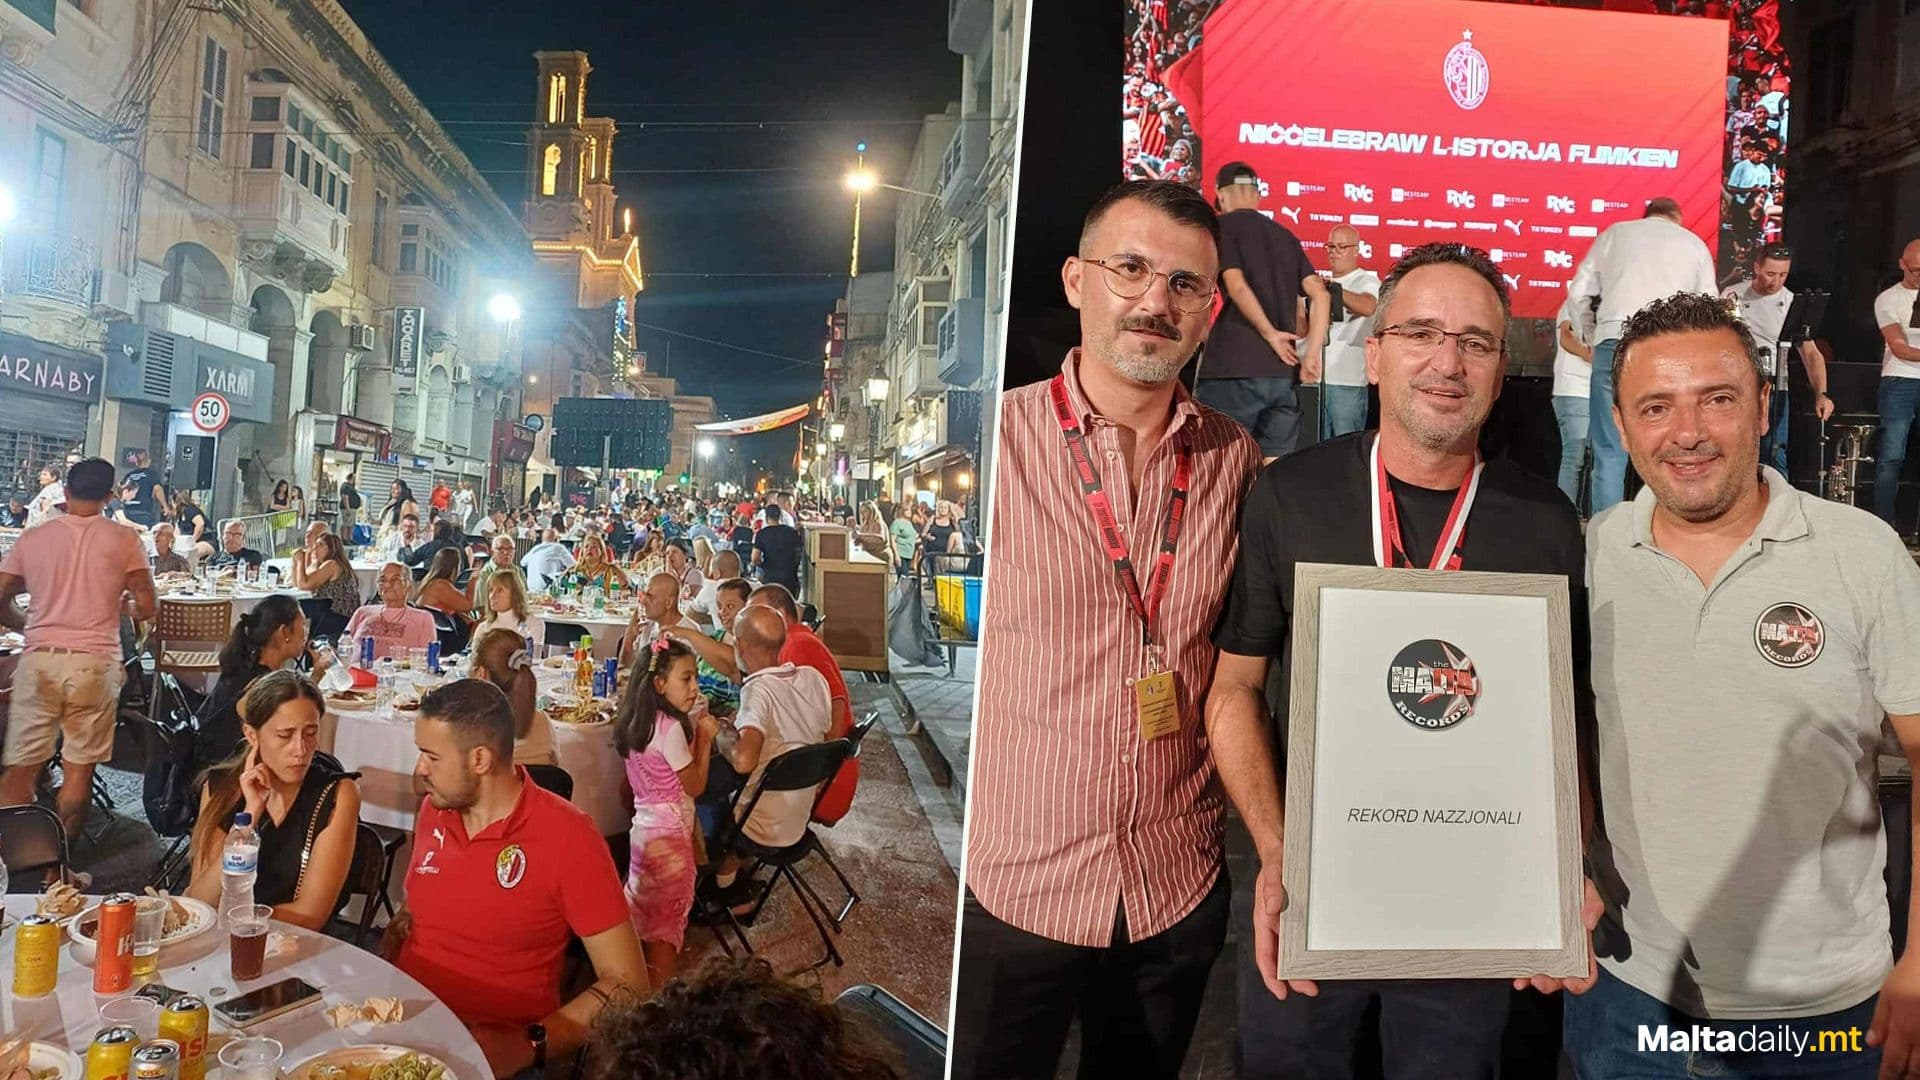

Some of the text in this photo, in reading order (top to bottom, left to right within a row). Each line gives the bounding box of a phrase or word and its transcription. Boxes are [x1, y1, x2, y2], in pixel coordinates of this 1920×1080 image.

[1432, 135, 1562, 162] L-ISTORJA
[1568, 144, 1679, 168] FLIMKIEN
[0, 353, 95, 396] ARNABY
[205, 366, 248, 397] XARM
[200, 400, 220, 417] 50
[1391, 666, 1477, 695] MALTA
[1396, 700, 1469, 727] RECORDS
[1347, 809, 1521, 825] REKORD NAZZJONALI
